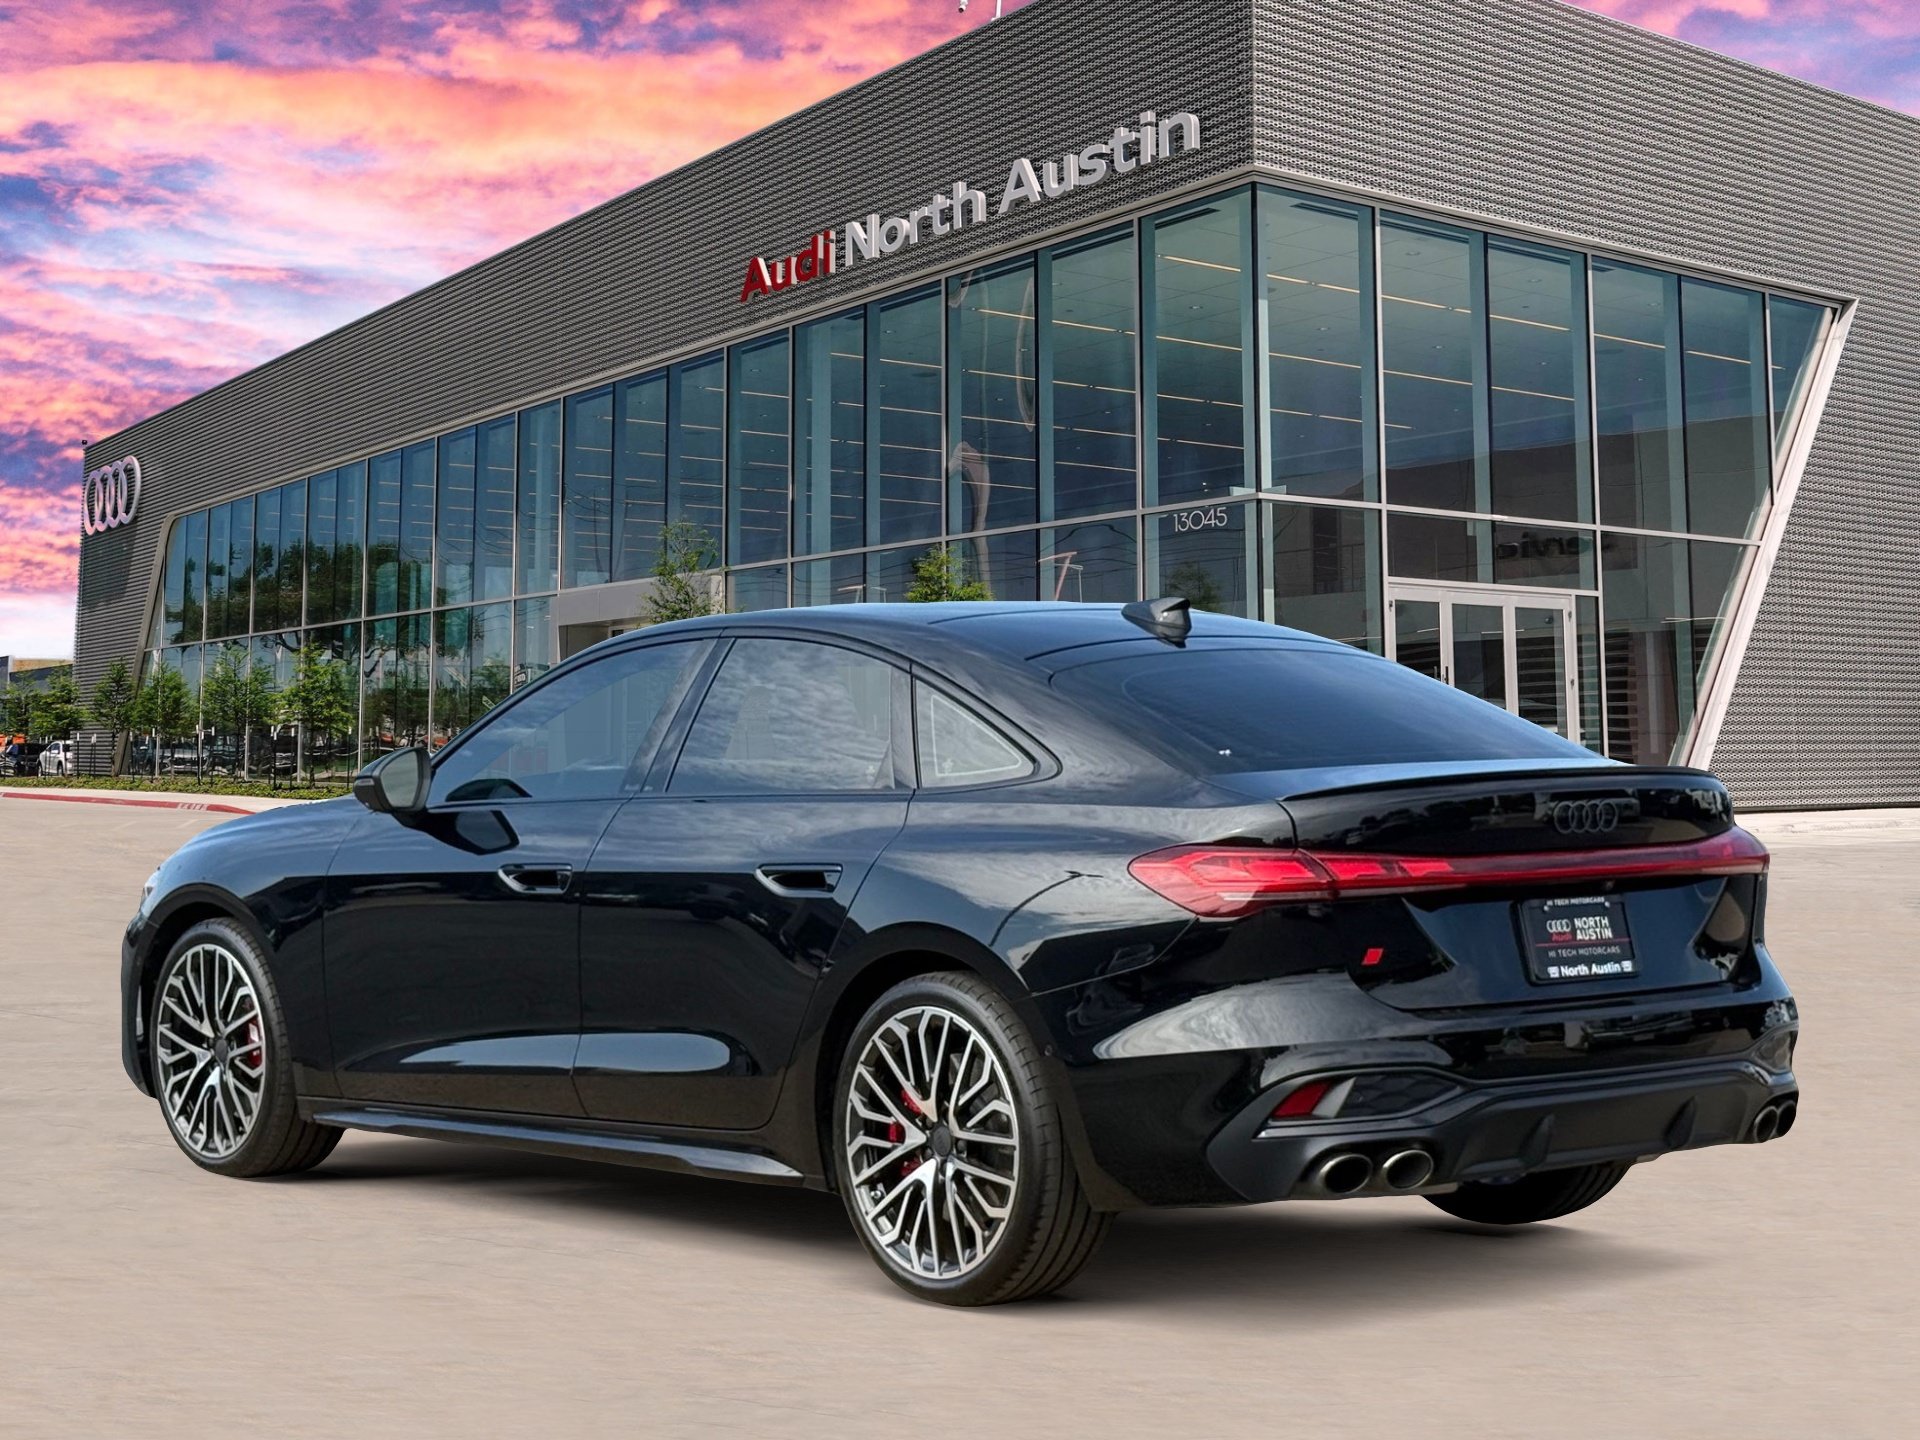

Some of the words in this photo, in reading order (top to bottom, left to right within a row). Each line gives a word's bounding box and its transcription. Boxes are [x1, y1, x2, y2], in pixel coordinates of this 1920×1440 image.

[740, 229, 836, 302] Audi
[844, 181, 987, 267] North
[999, 110, 1201, 215] Austin
[1173, 507, 1228, 532] 13045
[1574, 916, 1610, 930] NORTH
[1576, 928, 1613, 941] AUSTIN
[1558, 949, 1577, 957] TECH
[1578, 946, 1620, 955] MOTORCARS
[1560, 963, 1590, 977] North
[1591, 961, 1622, 975] Austin
